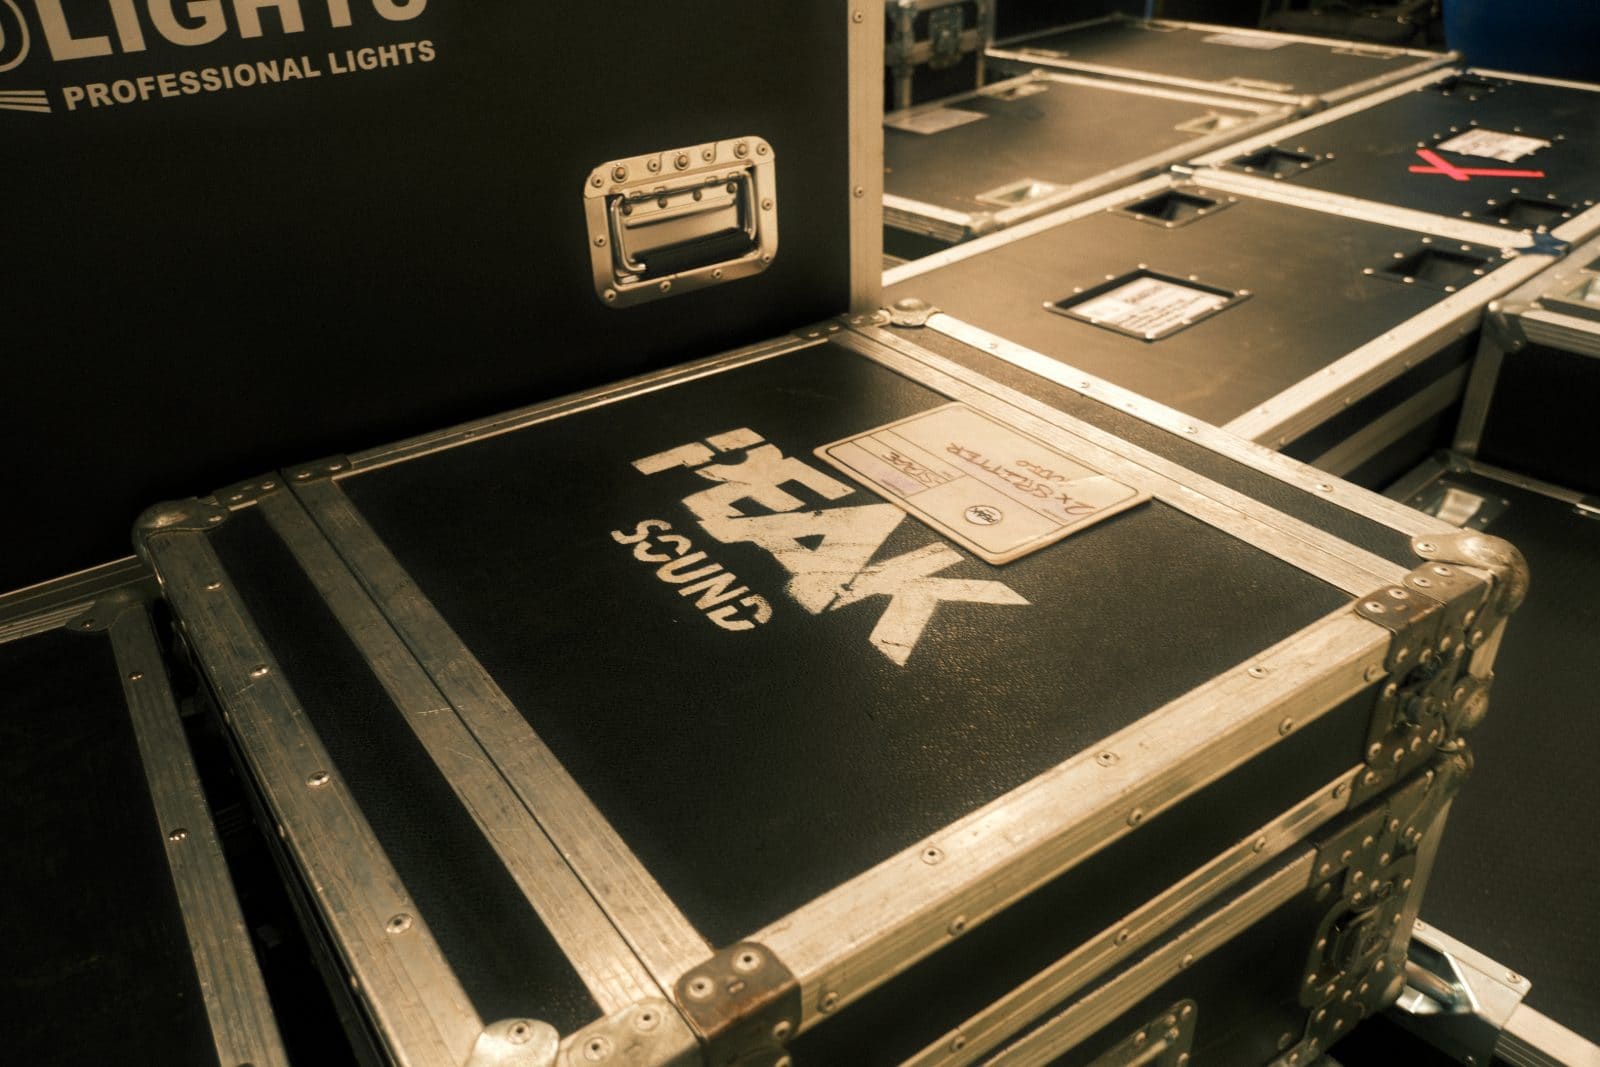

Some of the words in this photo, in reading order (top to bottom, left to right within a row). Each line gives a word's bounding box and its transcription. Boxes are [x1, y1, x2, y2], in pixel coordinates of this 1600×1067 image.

[62, 49, 322, 111] PROFESSIONAL
[328, 39, 436, 75] LIGHTS
[611, 518, 773, 633] SOUND
[631, 427, 1031, 669] PEAK
